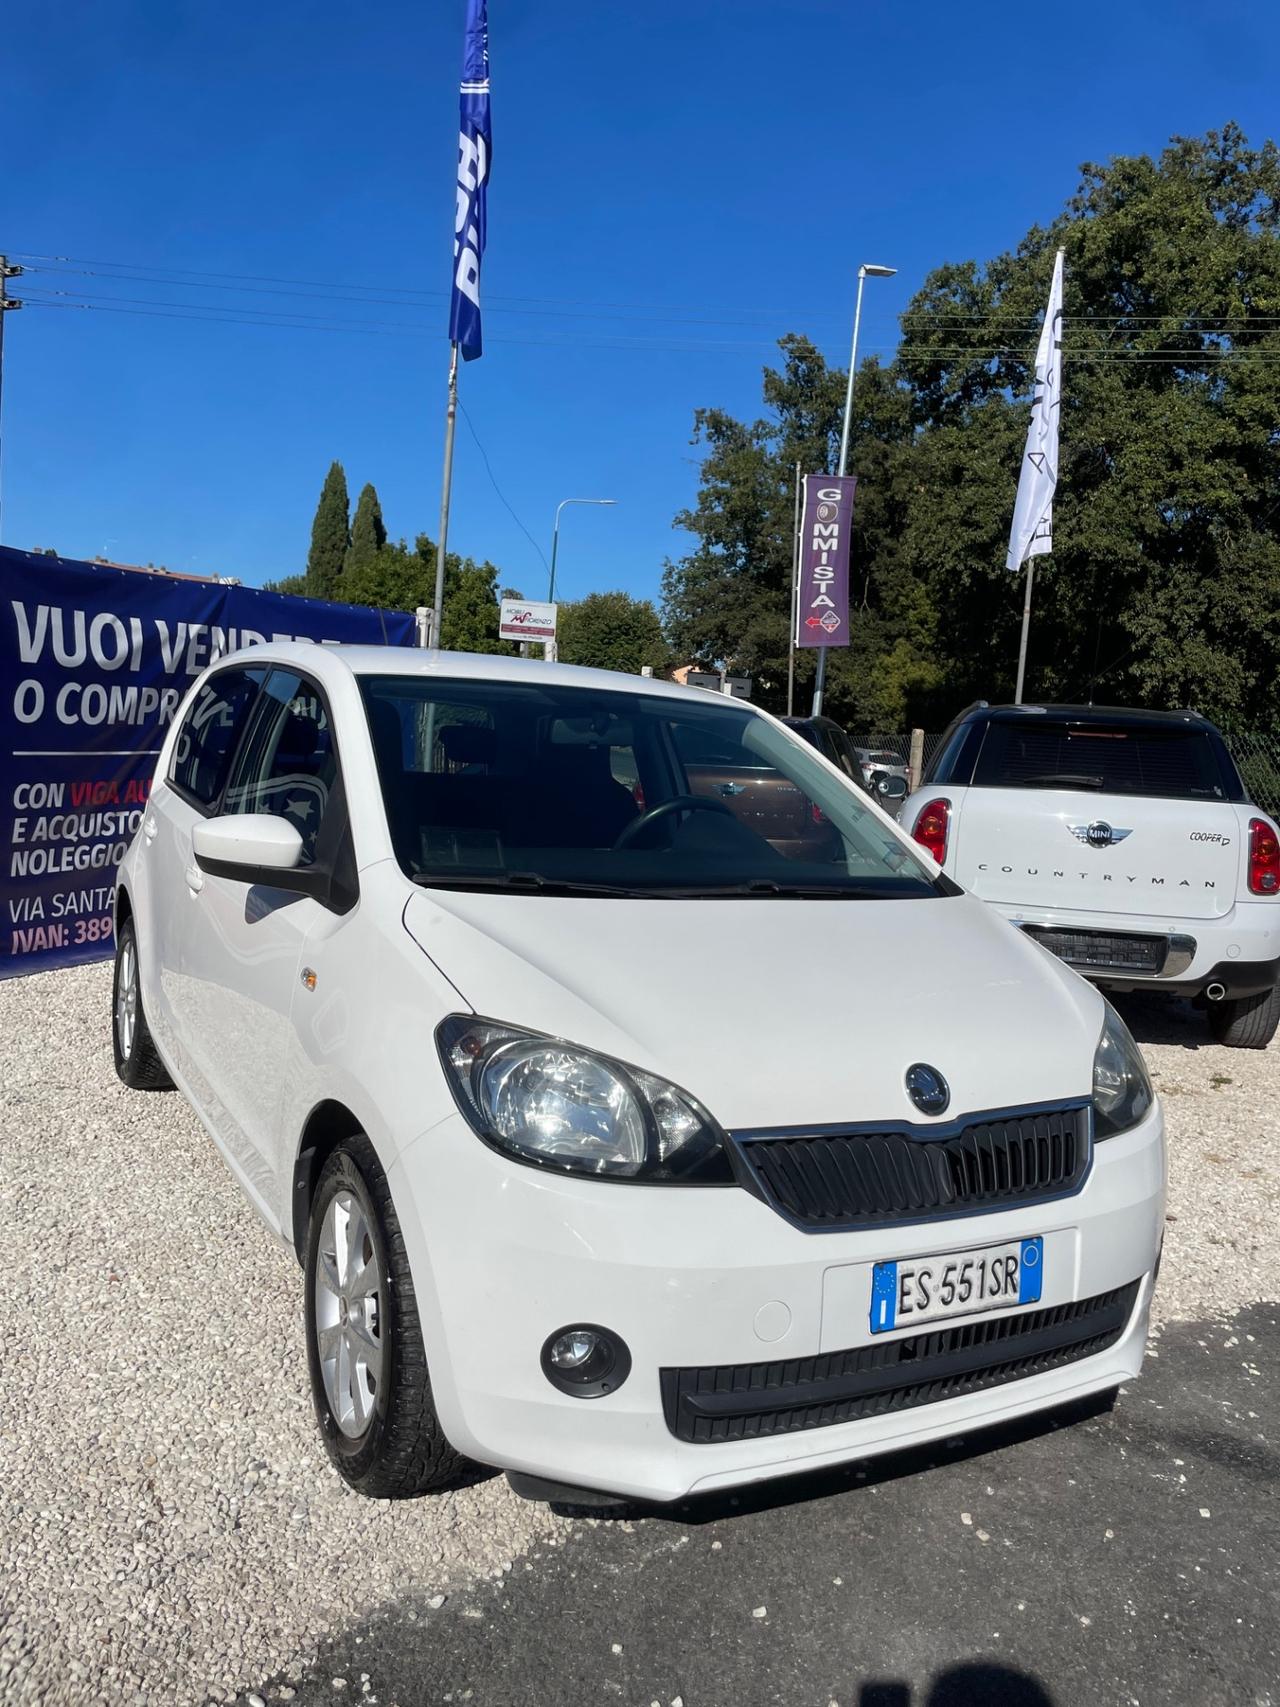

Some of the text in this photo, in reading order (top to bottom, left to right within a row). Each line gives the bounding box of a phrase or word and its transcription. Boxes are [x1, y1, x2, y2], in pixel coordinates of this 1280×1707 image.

[11, 600, 145, 672] VUOI
[13, 679, 45, 724] O
[13, 783, 65, 810] CON
[71, 781, 119, 808] VIGA
[11, 810, 142, 844] E ACQUISTO
[1089, 829, 1111, 840] MINI
[1189, 832, 1222, 842] COOPER
[10, 842, 128, 878] NOLEGGIO
[978, 863, 1216, 888] COUNTRYMAN
[9, 887, 116, 924] VIA SANTA
[11, 916, 113, 956] IVAN: 389
